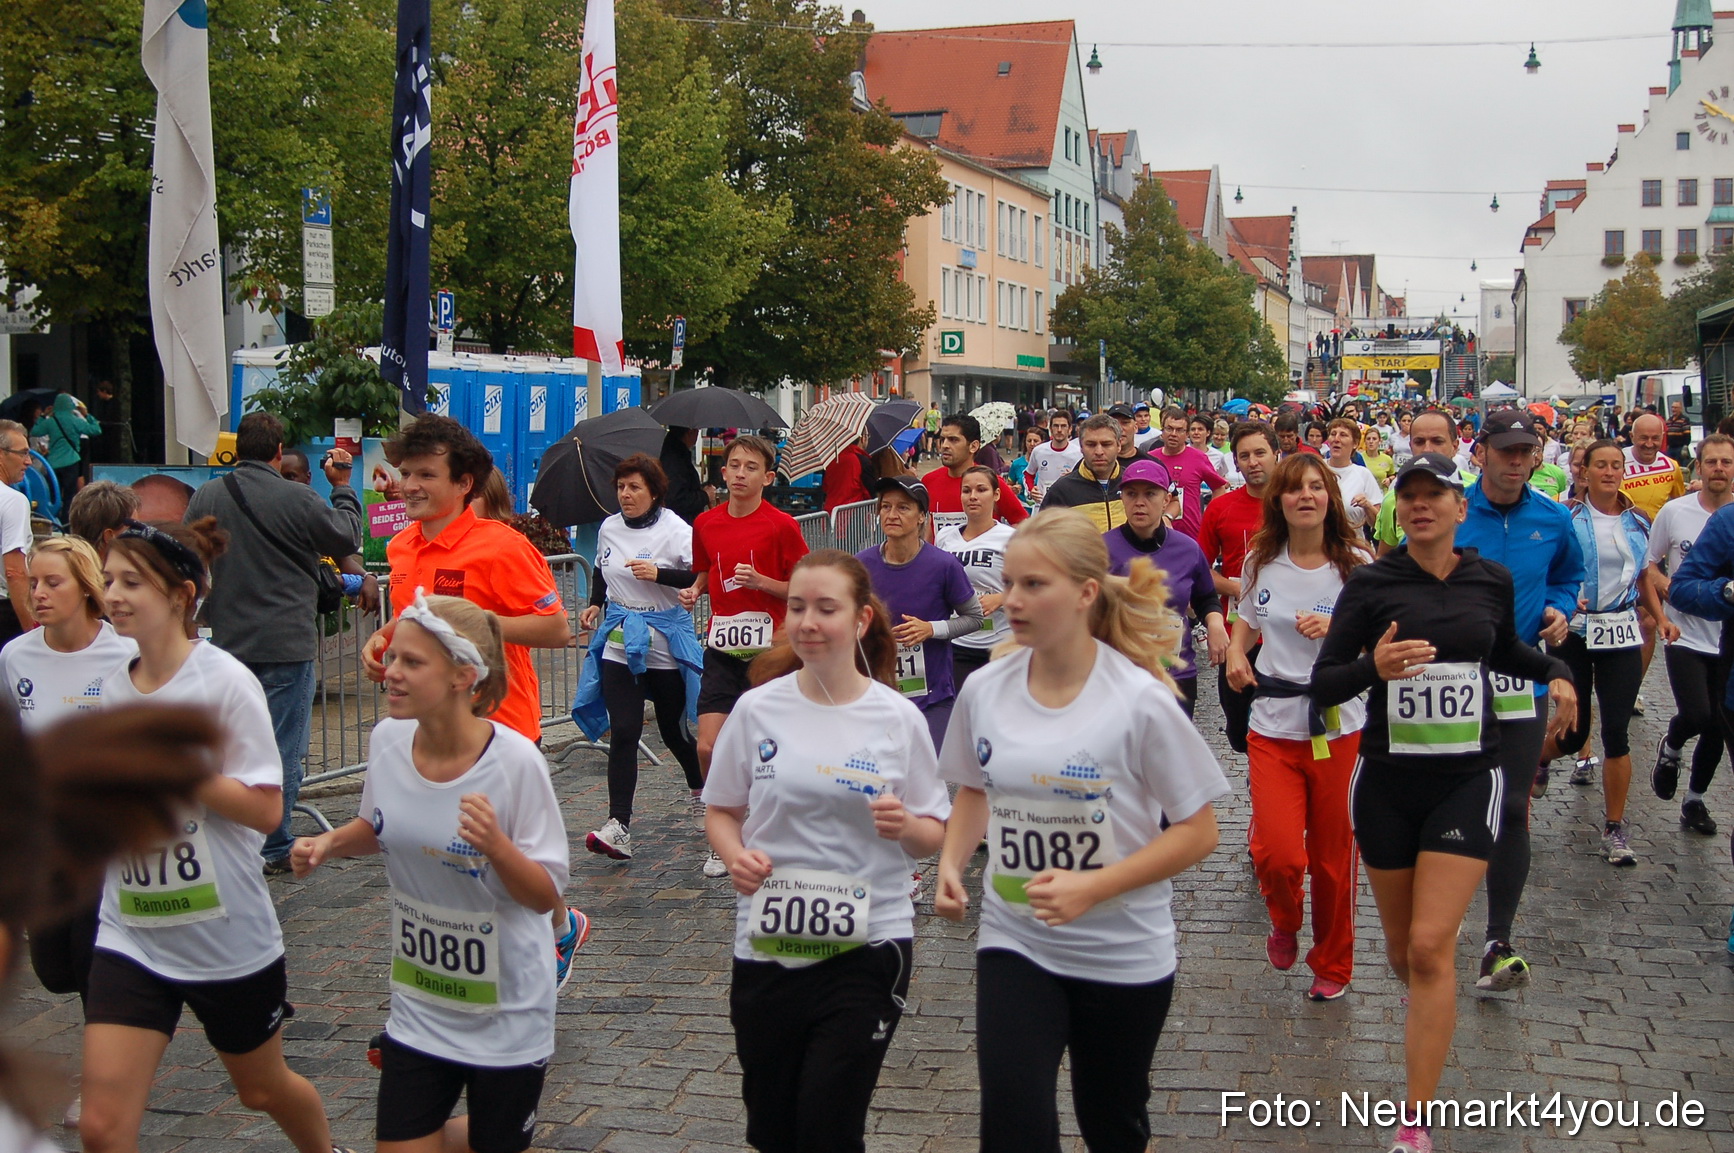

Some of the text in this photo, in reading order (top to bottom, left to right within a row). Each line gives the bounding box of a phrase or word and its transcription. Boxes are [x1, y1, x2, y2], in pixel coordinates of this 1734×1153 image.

[441, 297, 451, 325] P
[676, 322, 684, 345] P
[944, 334, 961, 351] D
[381, 342, 407, 368] uto
[1373, 358, 1407, 367] START
[484, 390, 502, 414] DIXI
[529, 390, 547, 413] DIXI
[1624, 474, 1675, 490] MAX BÖGL
[372, 513, 395, 525] BEIDE
[714, 625, 764, 648] 5061
[1593, 624, 1636, 645] 2194
[895, 654, 917, 678] 41
[1422, 672, 1466, 682] Neumarkt
[1397, 684, 1475, 719] 5162
[992, 806, 1087, 825] PARTL Neumarkt
[1001, 826, 1104, 872] 5082
[794, 880, 849, 896] Neumarkt
[133, 896, 191, 913] Ramona
[394, 898, 474, 933] PARTL Neumarkt
[760, 895, 856, 937] 5083
[400, 918, 486, 975] 5080
[775, 939, 841, 956] Jeanette
[415, 970, 467, 998] Daniela
